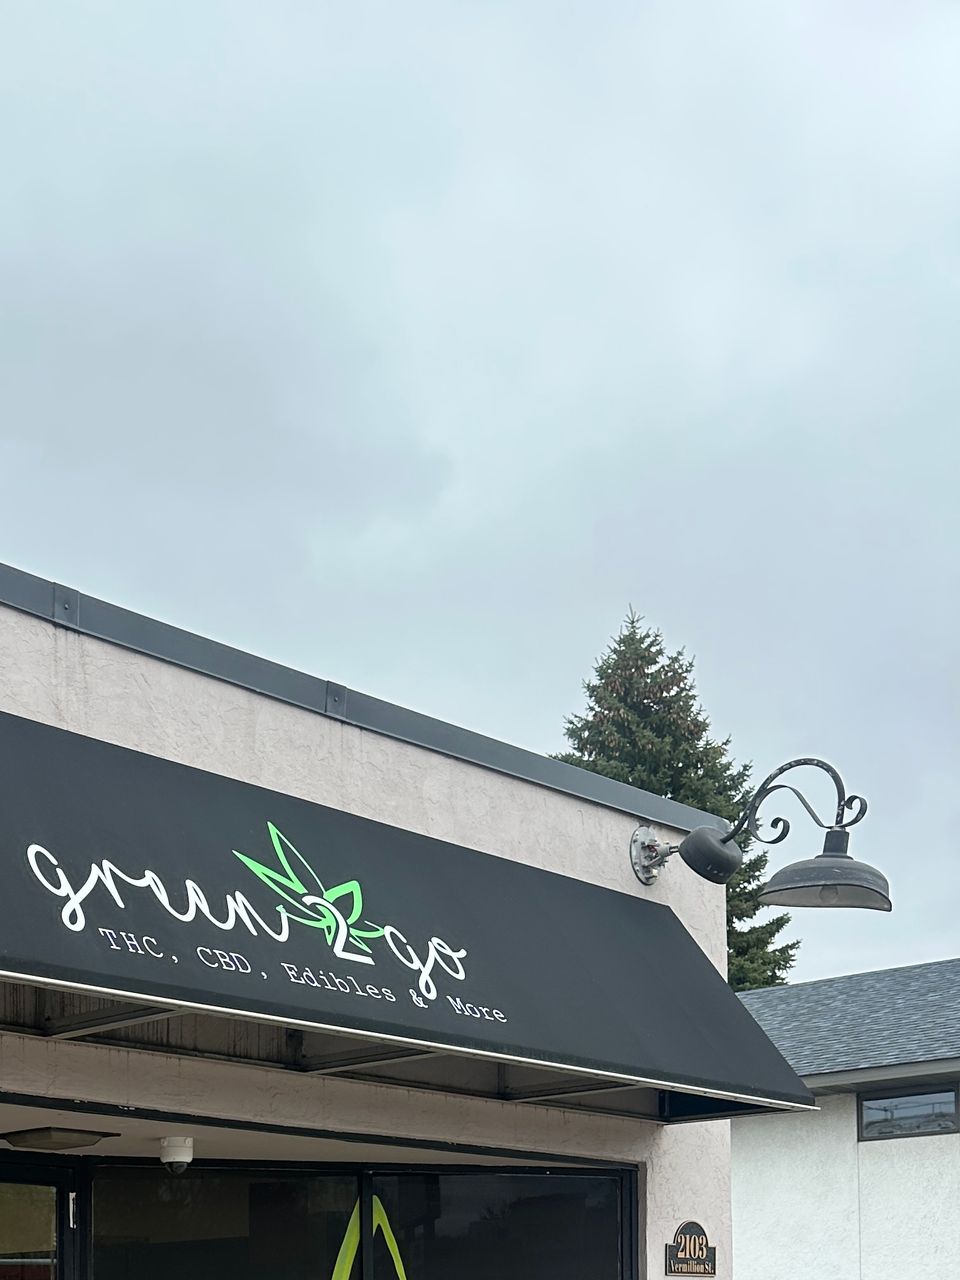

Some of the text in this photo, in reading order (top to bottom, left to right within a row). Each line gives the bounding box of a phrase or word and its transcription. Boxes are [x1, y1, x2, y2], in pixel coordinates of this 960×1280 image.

[98, 928, 508, 1024] THC, CBD, Edibles & More
[677, 1234, 707, 1259] 2103
[670, 1260, 704, 1273] Vermillion
